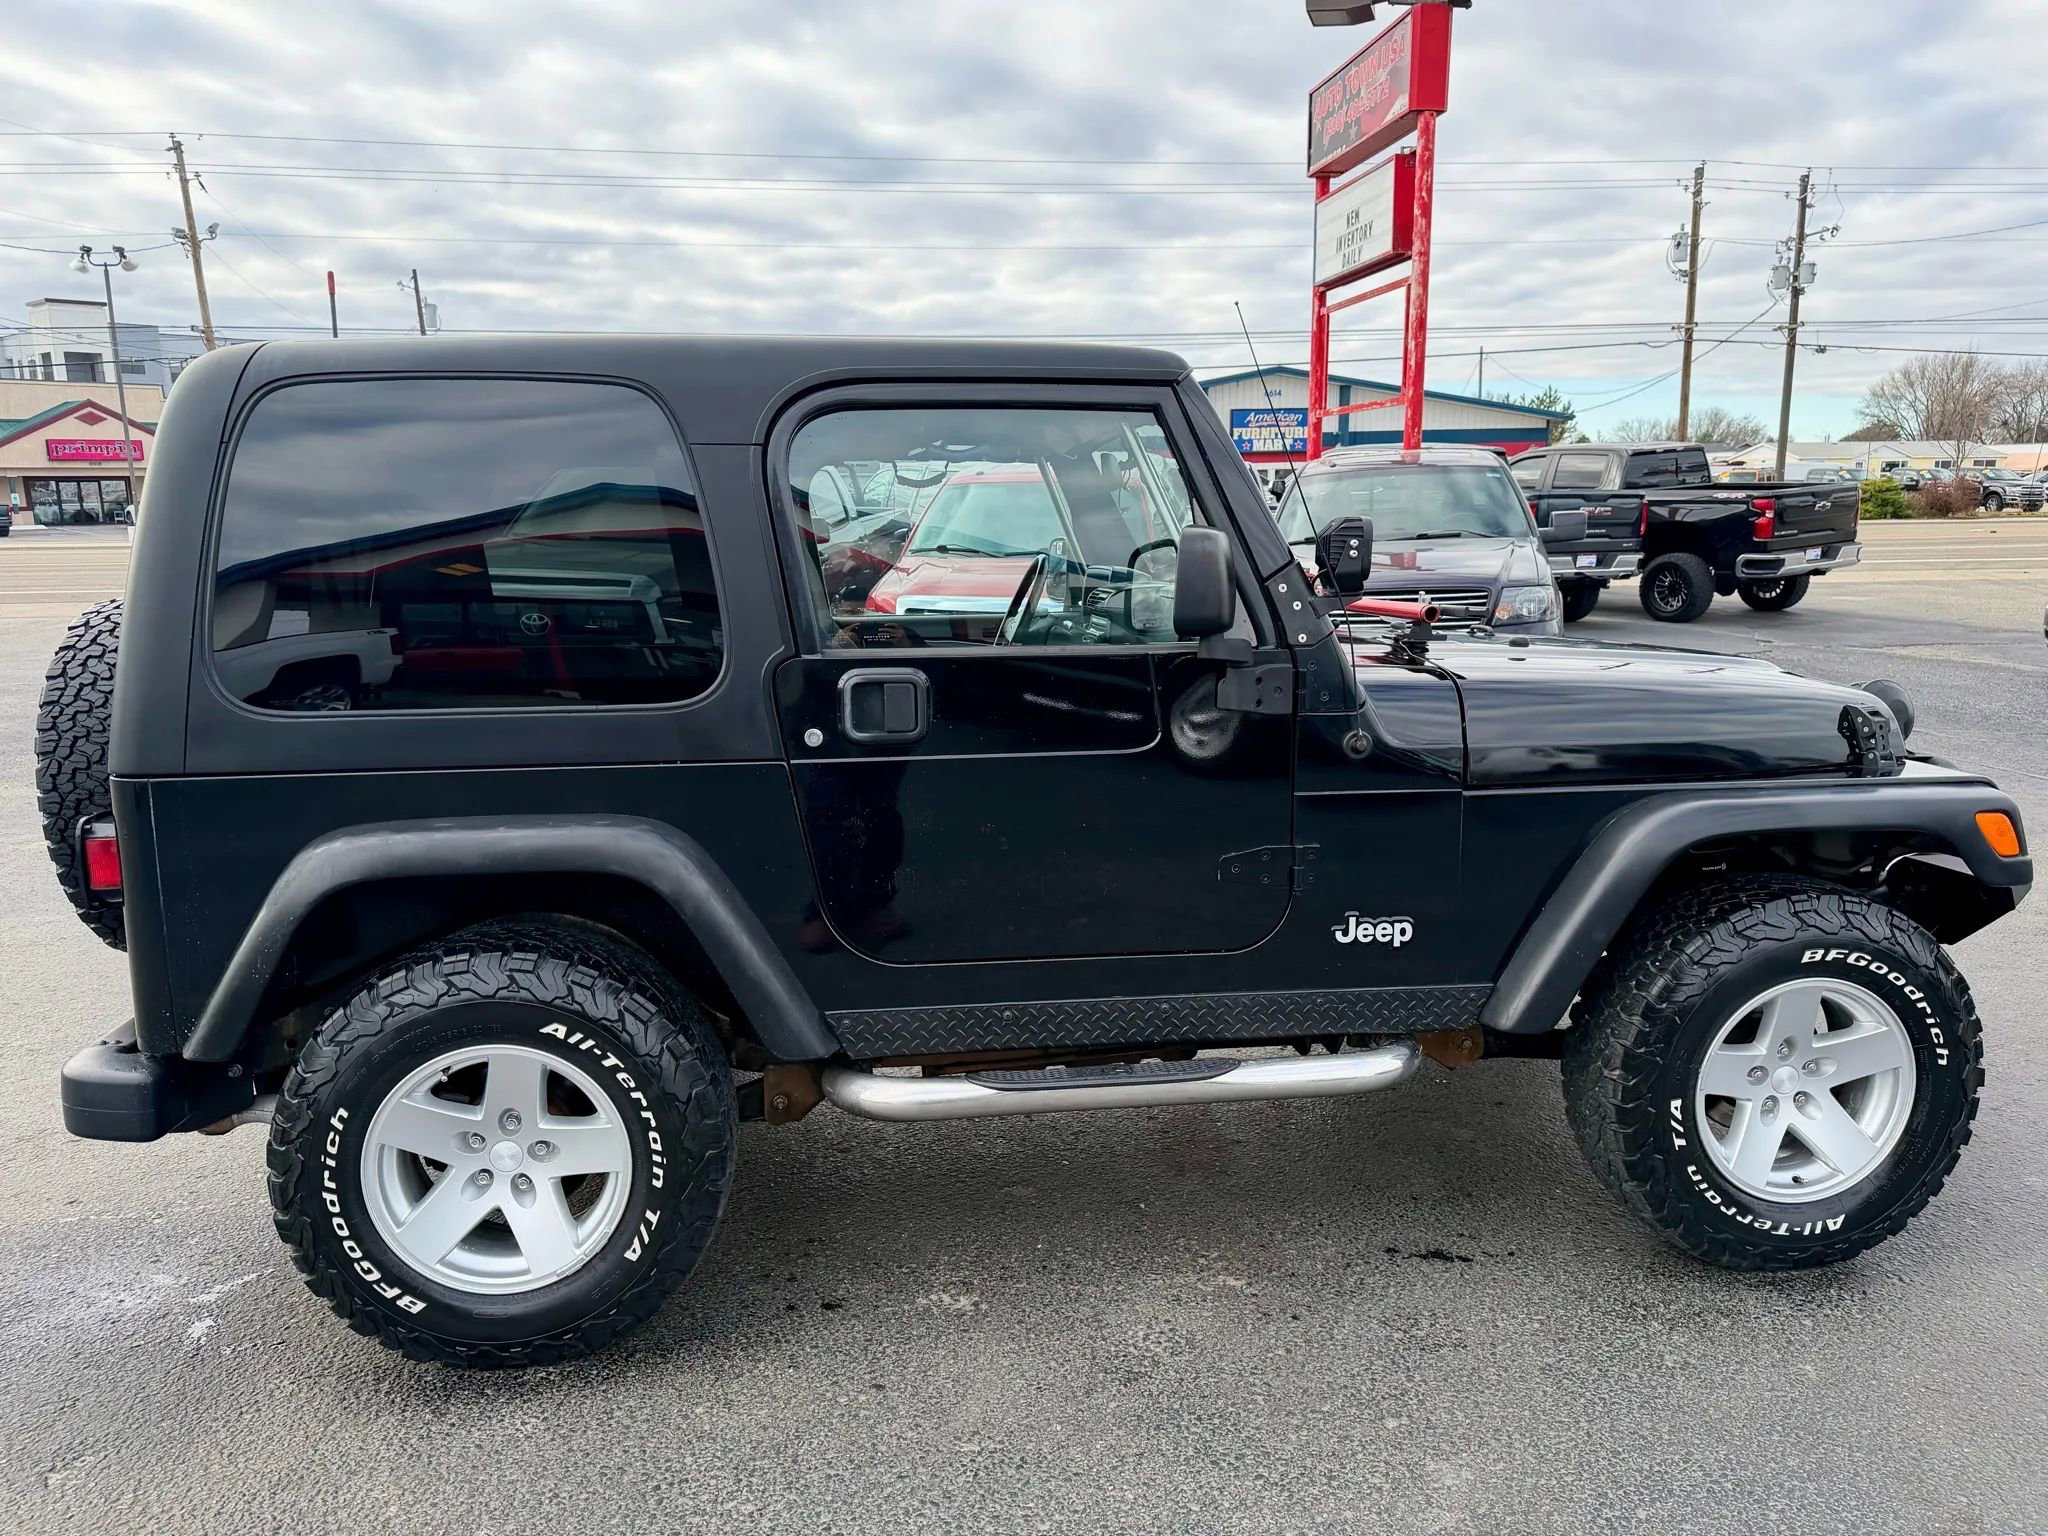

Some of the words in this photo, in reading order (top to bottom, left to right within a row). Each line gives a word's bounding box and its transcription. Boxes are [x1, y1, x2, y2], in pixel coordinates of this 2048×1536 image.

[1314, 80, 1343, 120] AUTO
[1345, 52, 1378, 99] TOWN
[1380, 32, 1407, 73] USA
[1342, 247, 1363, 269] DAILY
[1244, 410, 1303, 423] American
[1252, 438, 1294, 451] MART
[1332, 911, 1414, 947] Jeep
[1800, 948, 1948, 1066] BFGoodrich
[539, 1021, 669, 1189] All-Terrain
[624, 1208, 662, 1262] T/A
[1670, 1097, 1687, 1151] T/A
[320, 1106, 428, 1315] BFGoodrich
[1687, 1165, 1846, 1236] All-Terrain
